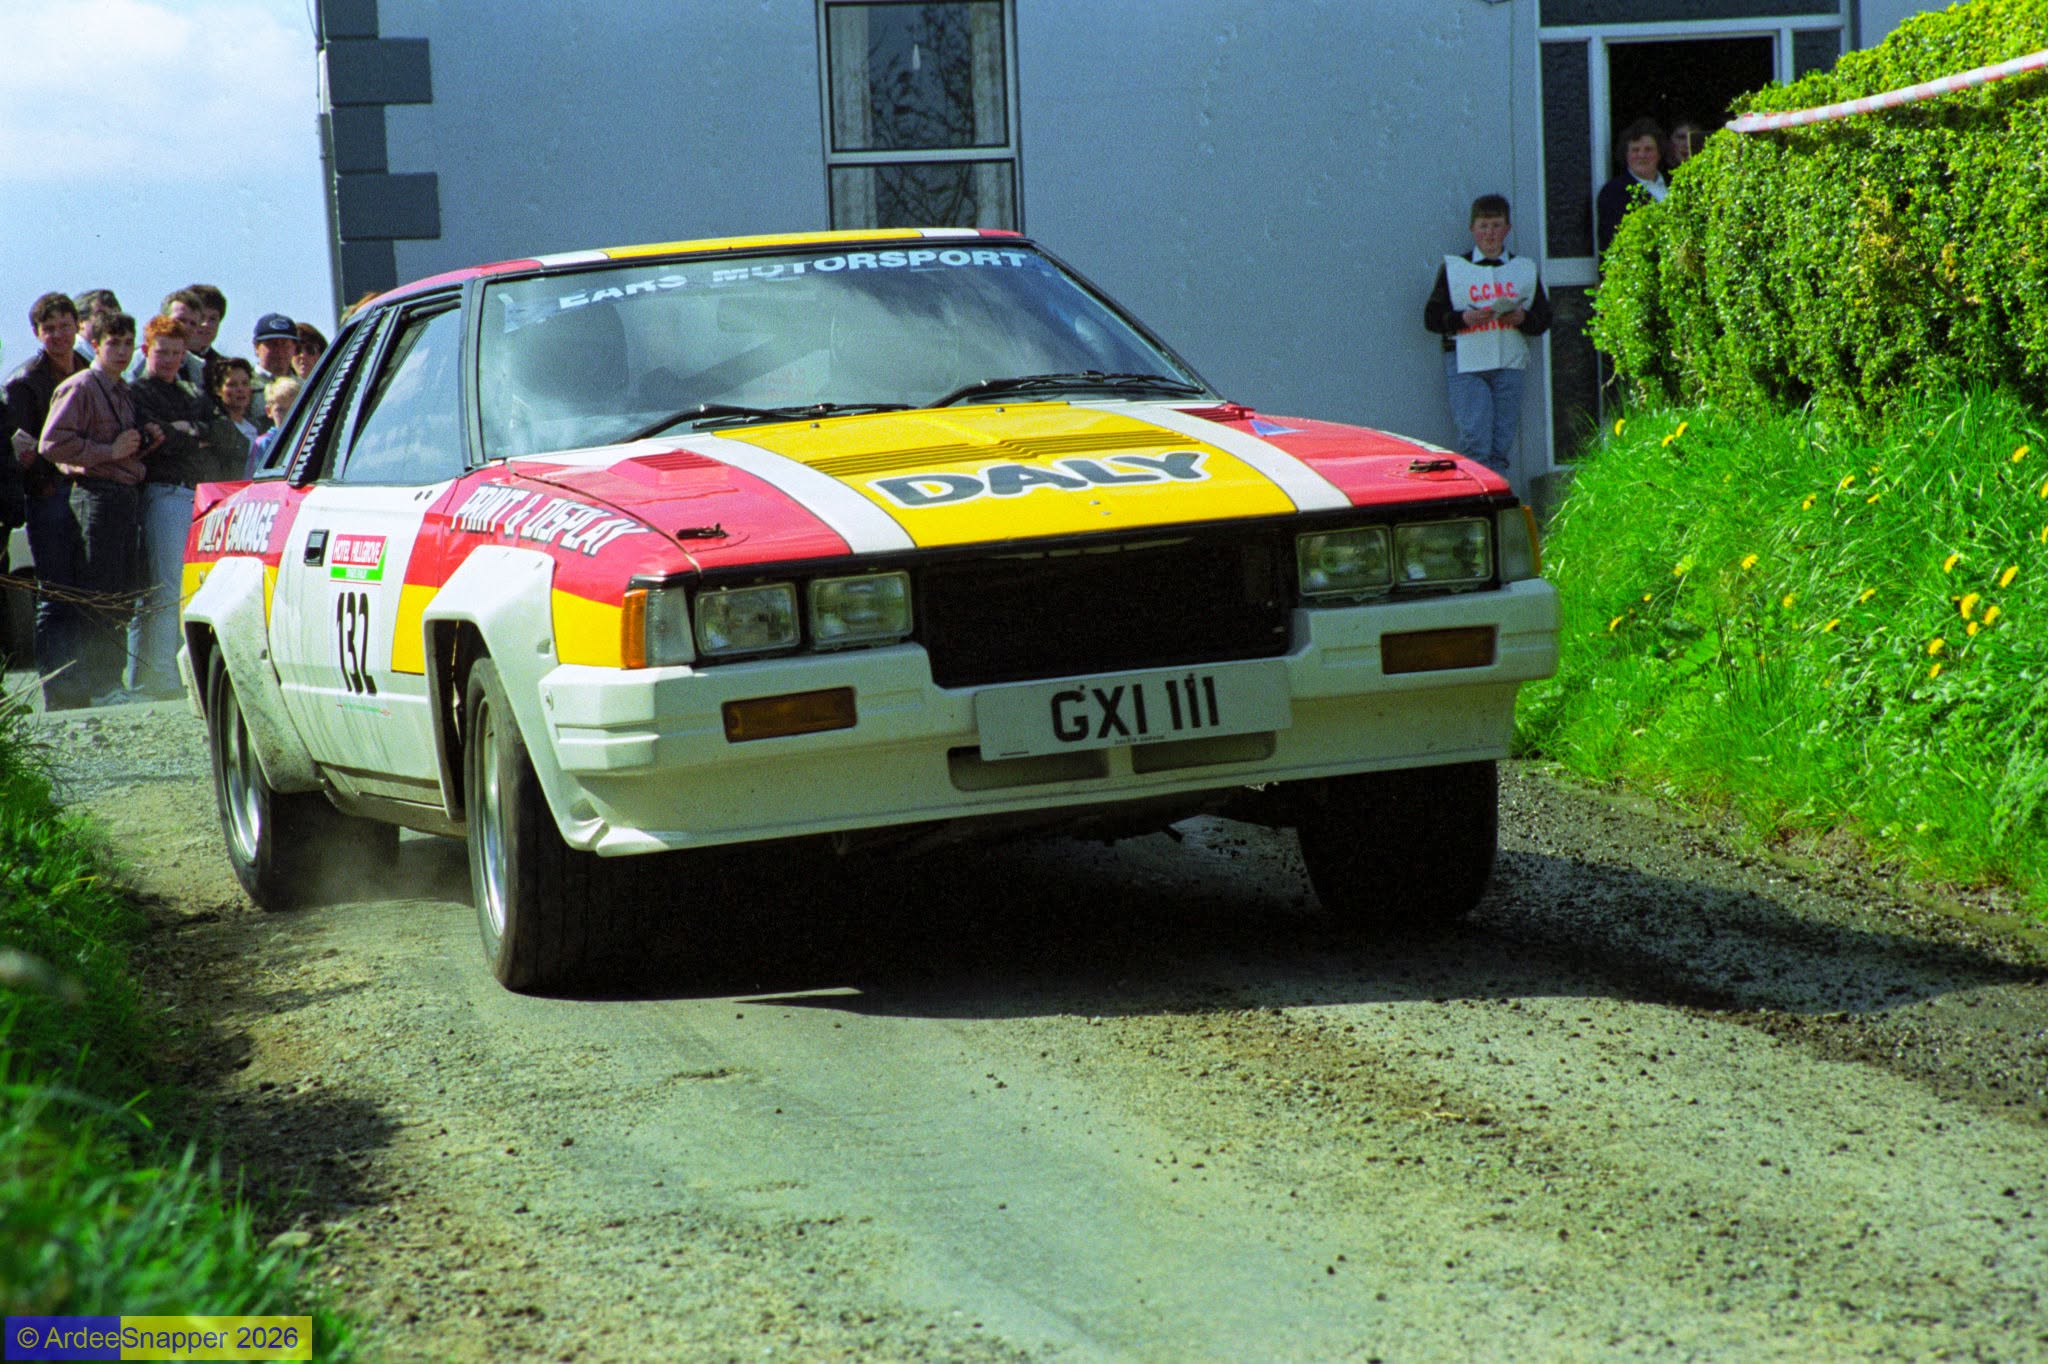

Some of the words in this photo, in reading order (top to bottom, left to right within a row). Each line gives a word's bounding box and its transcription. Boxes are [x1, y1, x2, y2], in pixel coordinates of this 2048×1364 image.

[712, 250, 1028, 283] MOTORSPORT
[872, 451, 1206, 507] DALY
[224, 501, 280, 554] GARAGE
[450, 485, 533, 533] PRINT
[503, 493, 546, 538] &
[519, 498, 654, 558] DISPLAY
[336, 591, 378, 696] 132
[1050, 683, 1147, 743] GXI
